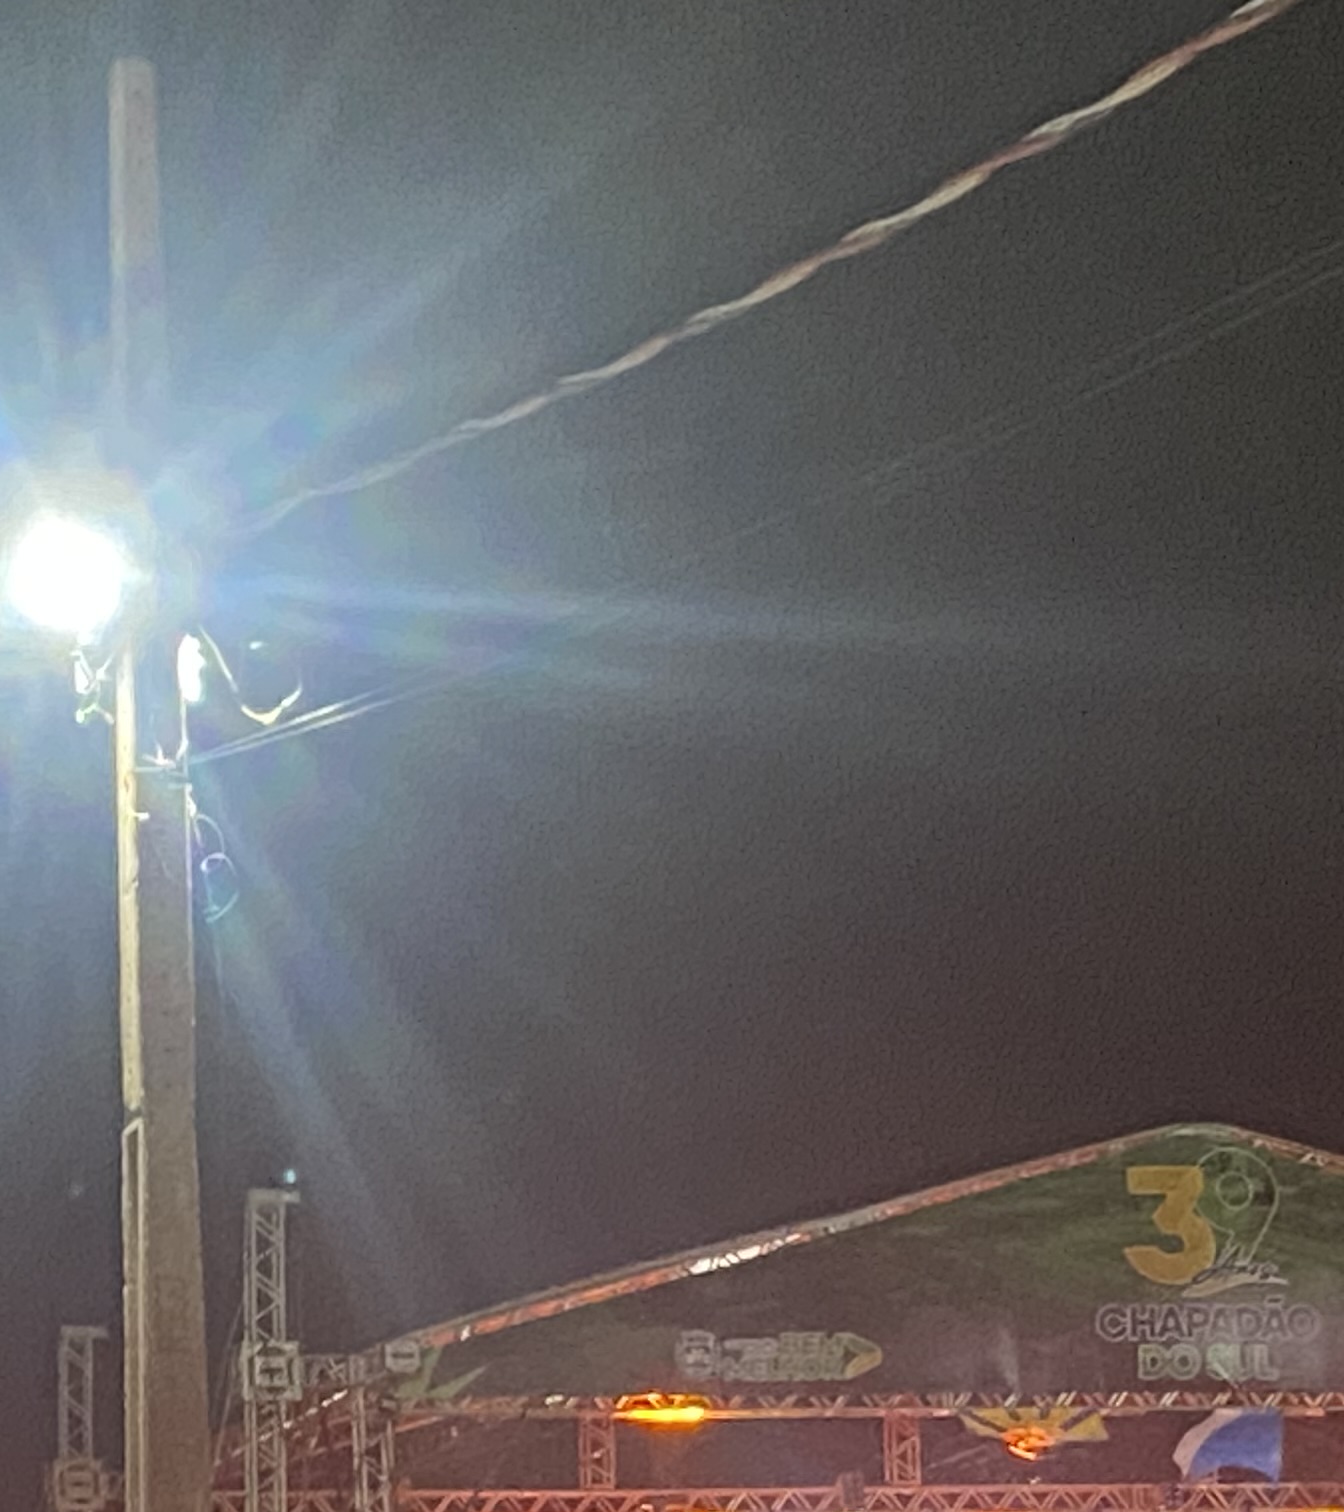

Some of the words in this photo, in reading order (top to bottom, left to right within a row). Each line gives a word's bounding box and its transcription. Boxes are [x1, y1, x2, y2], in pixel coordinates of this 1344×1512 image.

[1096, 1297, 1319, 1342] CHAPADÃO
[1139, 1343, 1201, 1380] DO
[1207, 1343, 1278, 1380] SUL
